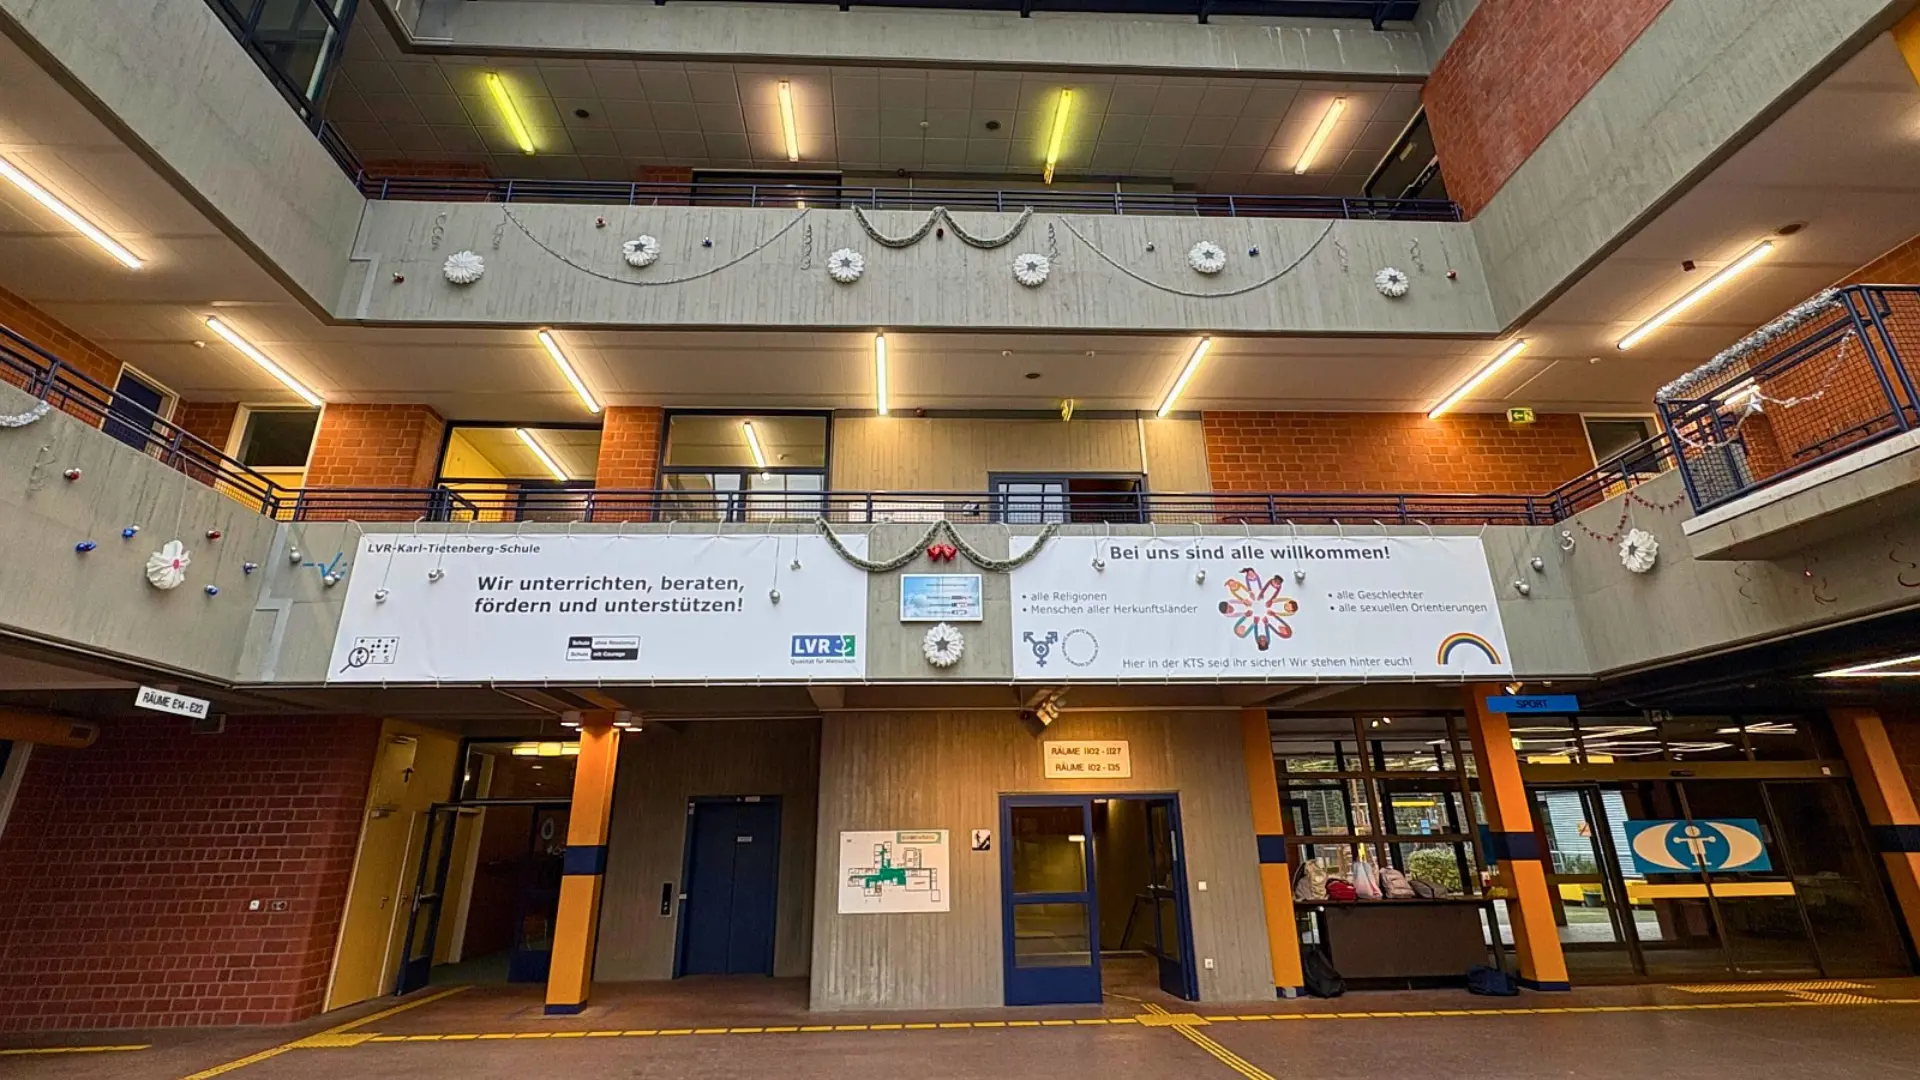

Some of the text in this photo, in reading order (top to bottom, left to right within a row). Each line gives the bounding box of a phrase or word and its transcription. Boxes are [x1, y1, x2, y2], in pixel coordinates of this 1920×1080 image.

[367, 543, 541, 556] LVR-Karl-Tietenberg-Schule
[1110, 546, 1391, 559] Bei uns sind alle willkommen!
[478, 575, 745, 593] Wir unterrichten, beraten,
[1031, 592, 1107, 603] alle Religionen
[1336, 590, 1423, 600] alle Geschlechter
[474, 597, 744, 613] fördern und unterstützen!
[1031, 605, 1198, 614] Menschen aller Herkunftsländer
[1338, 603, 1488, 614] alle sexuellen Orientierungen
[794, 638, 830, 654] LVR
[1122, 656, 1413, 668] Hier in der KTS seid ihr sicher! Wir stehen hinter euch!
[142, 691, 171, 707] RÄUME
[1516, 699, 1548, 708] SPORT
